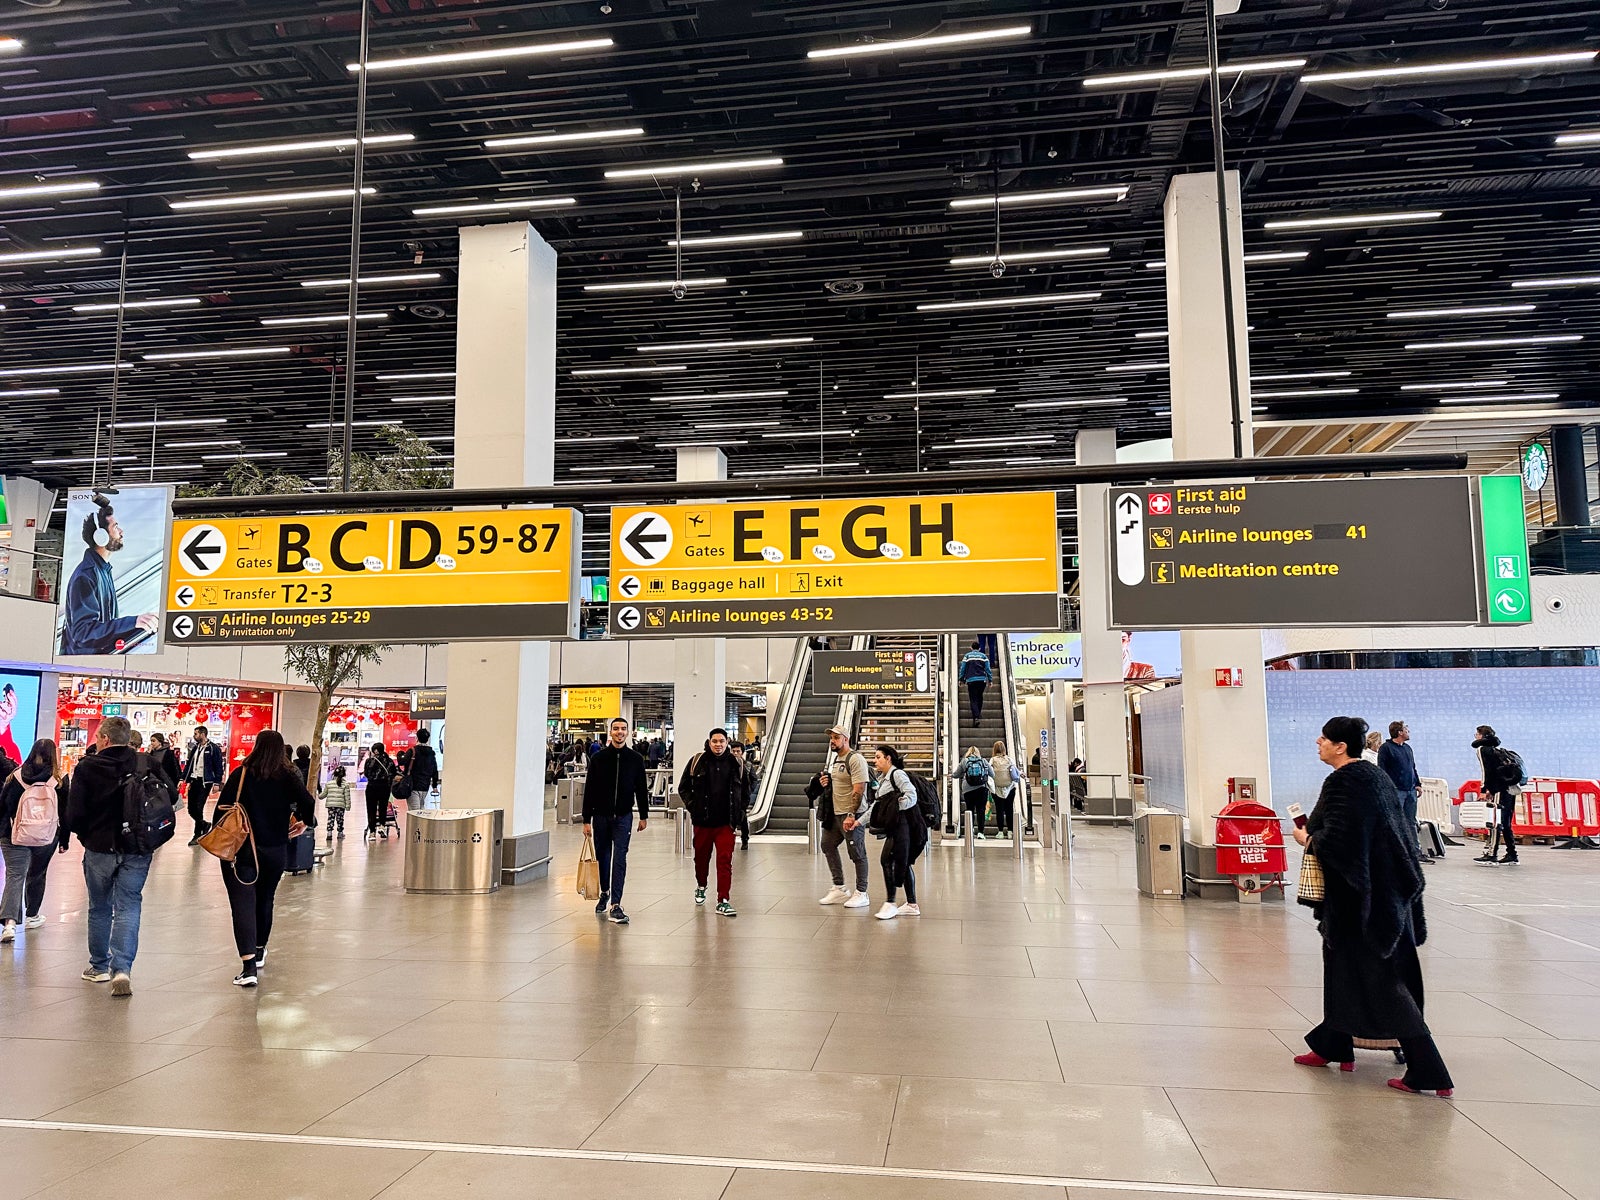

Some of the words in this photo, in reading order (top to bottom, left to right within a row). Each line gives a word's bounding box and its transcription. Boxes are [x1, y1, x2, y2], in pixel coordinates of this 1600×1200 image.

[1176, 488, 1215, 502] First
[1219, 486, 1246, 502] aid
[1177, 504, 1212, 515] Eerste
[1214, 503, 1241, 515] hulp
[685, 545, 725, 557] Gates
[733, 509, 764, 562] E
[790, 508, 819, 560] F
[841, 505, 887, 559] G
[909, 502, 954, 557] H
[1178, 529, 1238, 544] Airline
[1242, 527, 1313, 545] lounges
[1346, 525, 1367, 540] 41
[236, 557, 273, 569] Gates
[277, 523, 311, 573] B
[330, 520, 368, 572] C
[399, 519, 442, 570] D
[457, 523, 560, 555] 59-87
[1179, 562, 1277, 579] Meditation
[1283, 562, 1339, 577] centre
[671, 579, 734, 594] Baggage
[739, 576, 765, 589] hall
[815, 575, 843, 588] Exit
[223, 588, 276, 600] Transfer
[281, 583, 333, 604] T2-3
[220, 612, 268, 626] Airline
[271, 611, 327, 628] lounges
[330, 610, 371, 624] 25-29
[669, 610, 721, 624] Airline
[725, 608, 786, 625] lounges
[790, 607, 833, 622] 43-52
[219, 627, 231, 638] By
[232, 626, 275, 637] invitation
[276, 626, 296, 638] only
[1010, 640, 1064, 652] Embrace
[1016, 655, 1037, 665] the
[1040, 654, 1081, 667] luxury
[855, 666, 882, 674] lounges
[101, 678, 165, 695] PERFUMES
[169, 684, 178, 697] &
[181, 683, 239, 700] COSMETICS
[81, 707, 98, 715] FORD
[1239, 834, 1263, 844] FIRE
[1241, 854, 1268, 863] REEL
